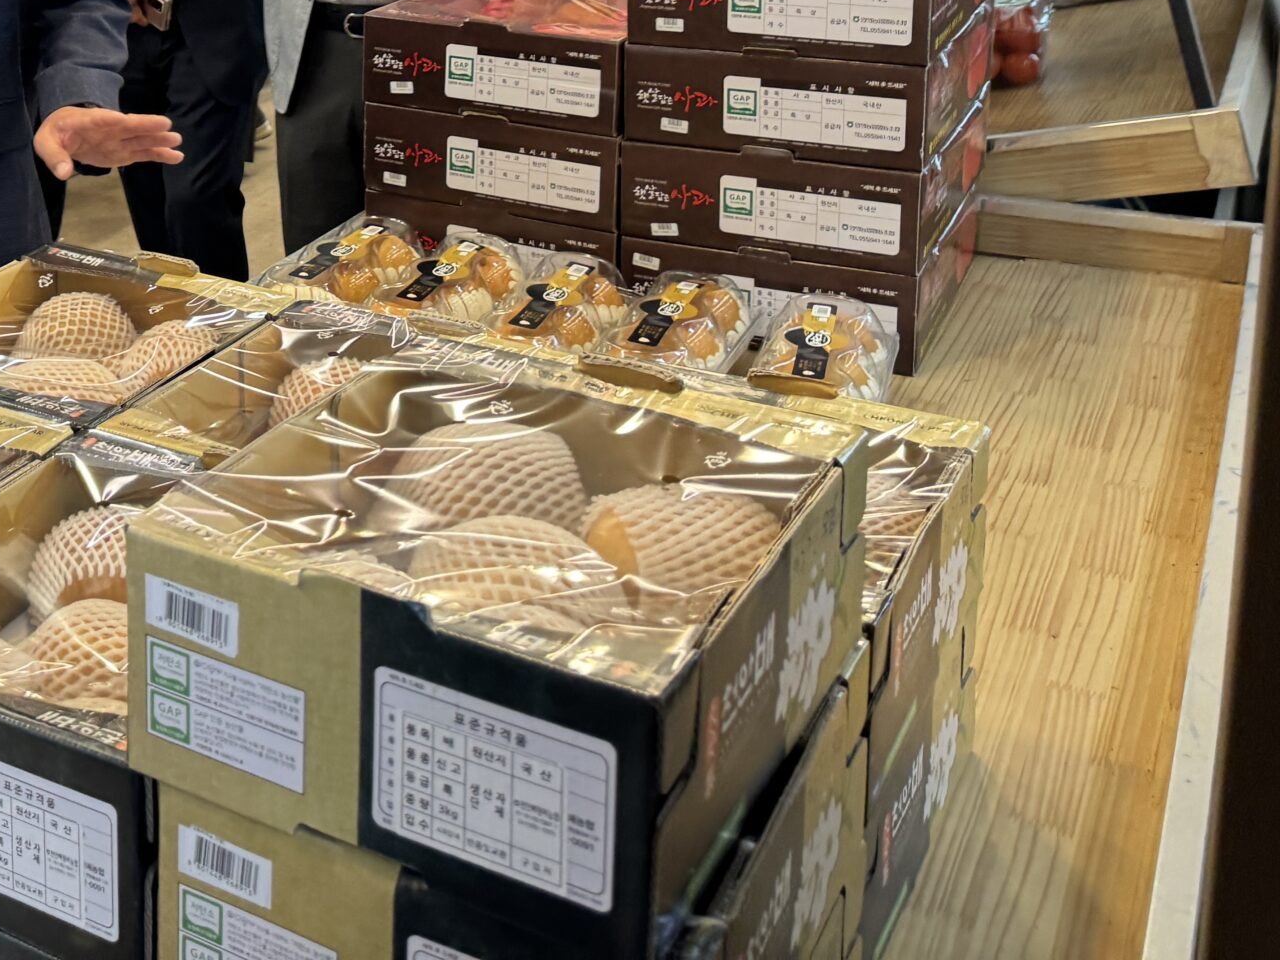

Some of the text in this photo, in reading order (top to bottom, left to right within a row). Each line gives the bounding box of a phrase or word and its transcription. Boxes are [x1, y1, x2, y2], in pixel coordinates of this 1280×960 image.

[404, 52, 443, 76] 사과
[453, 60, 469, 69] GAP
[674, 85, 719, 112] 사과
[733, 94, 751, 103] GAP
[406, 143, 442, 167] 사과
[454, 152, 470, 161] GAP
[671, 184, 714, 210] 사과
[729, 193, 747, 202] GAP
[158, 702, 182, 718] GAP
[454, 712, 527, 747] 표준규격품
[406, 723, 429, 740] 품목
[472, 745, 506, 767] 원산지
[522, 763, 552, 783] 국산
[436, 757, 461, 775] 신고
[3, 779, 56, 809] 표준규격품
[405, 770, 429, 789] 등급
[469, 783, 506, 805] 생산자
[405, 792, 459, 821] 중량 3kg
[15, 805, 40, 823] 원산지
[49, 819, 72, 835] 국산
[405, 813, 429, 831] 입수
[16, 835, 40, 853] 생산자
